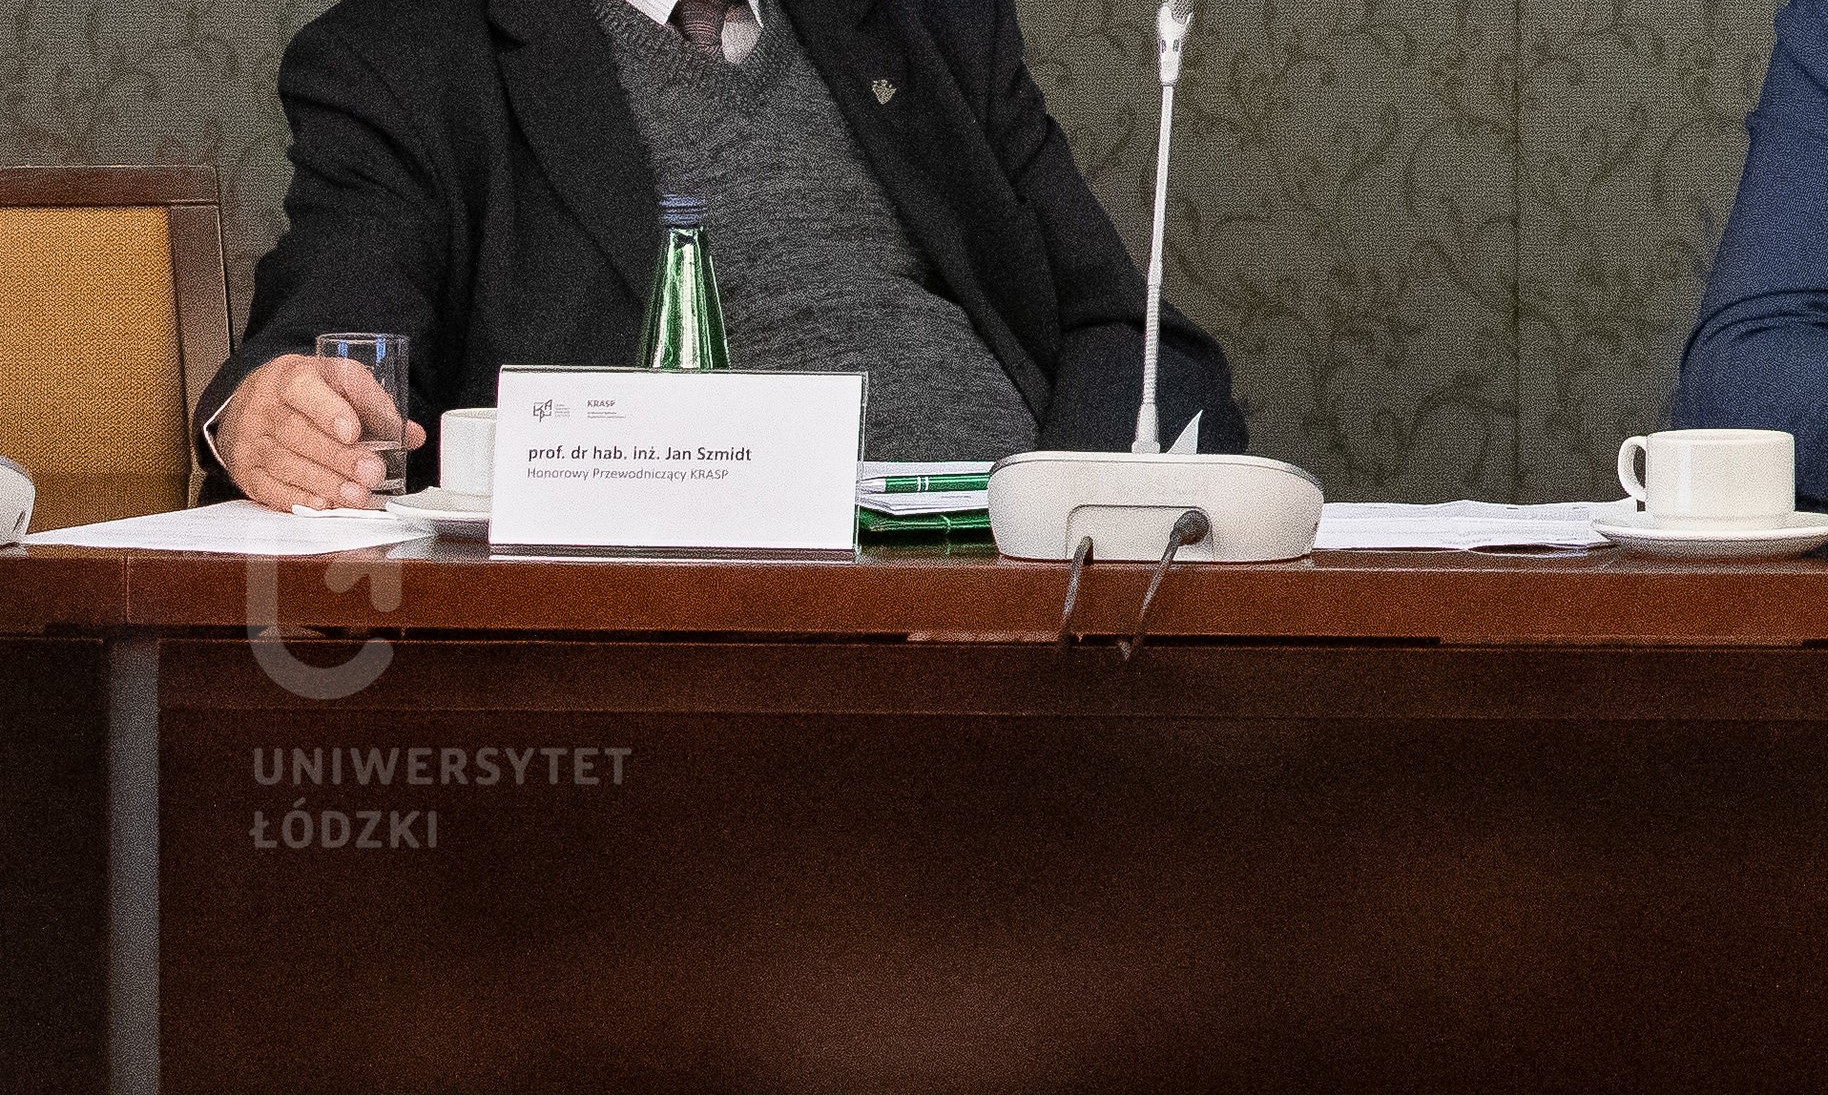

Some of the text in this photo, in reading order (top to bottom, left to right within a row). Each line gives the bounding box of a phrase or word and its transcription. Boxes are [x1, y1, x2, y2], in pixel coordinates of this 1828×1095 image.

[587, 400, 616, 408] KRASP
[529, 445, 752, 462] prof. dr hab. inż. Jan Szmidt
[527, 468, 729, 482] Honorowy Przewodniczący KRASP
